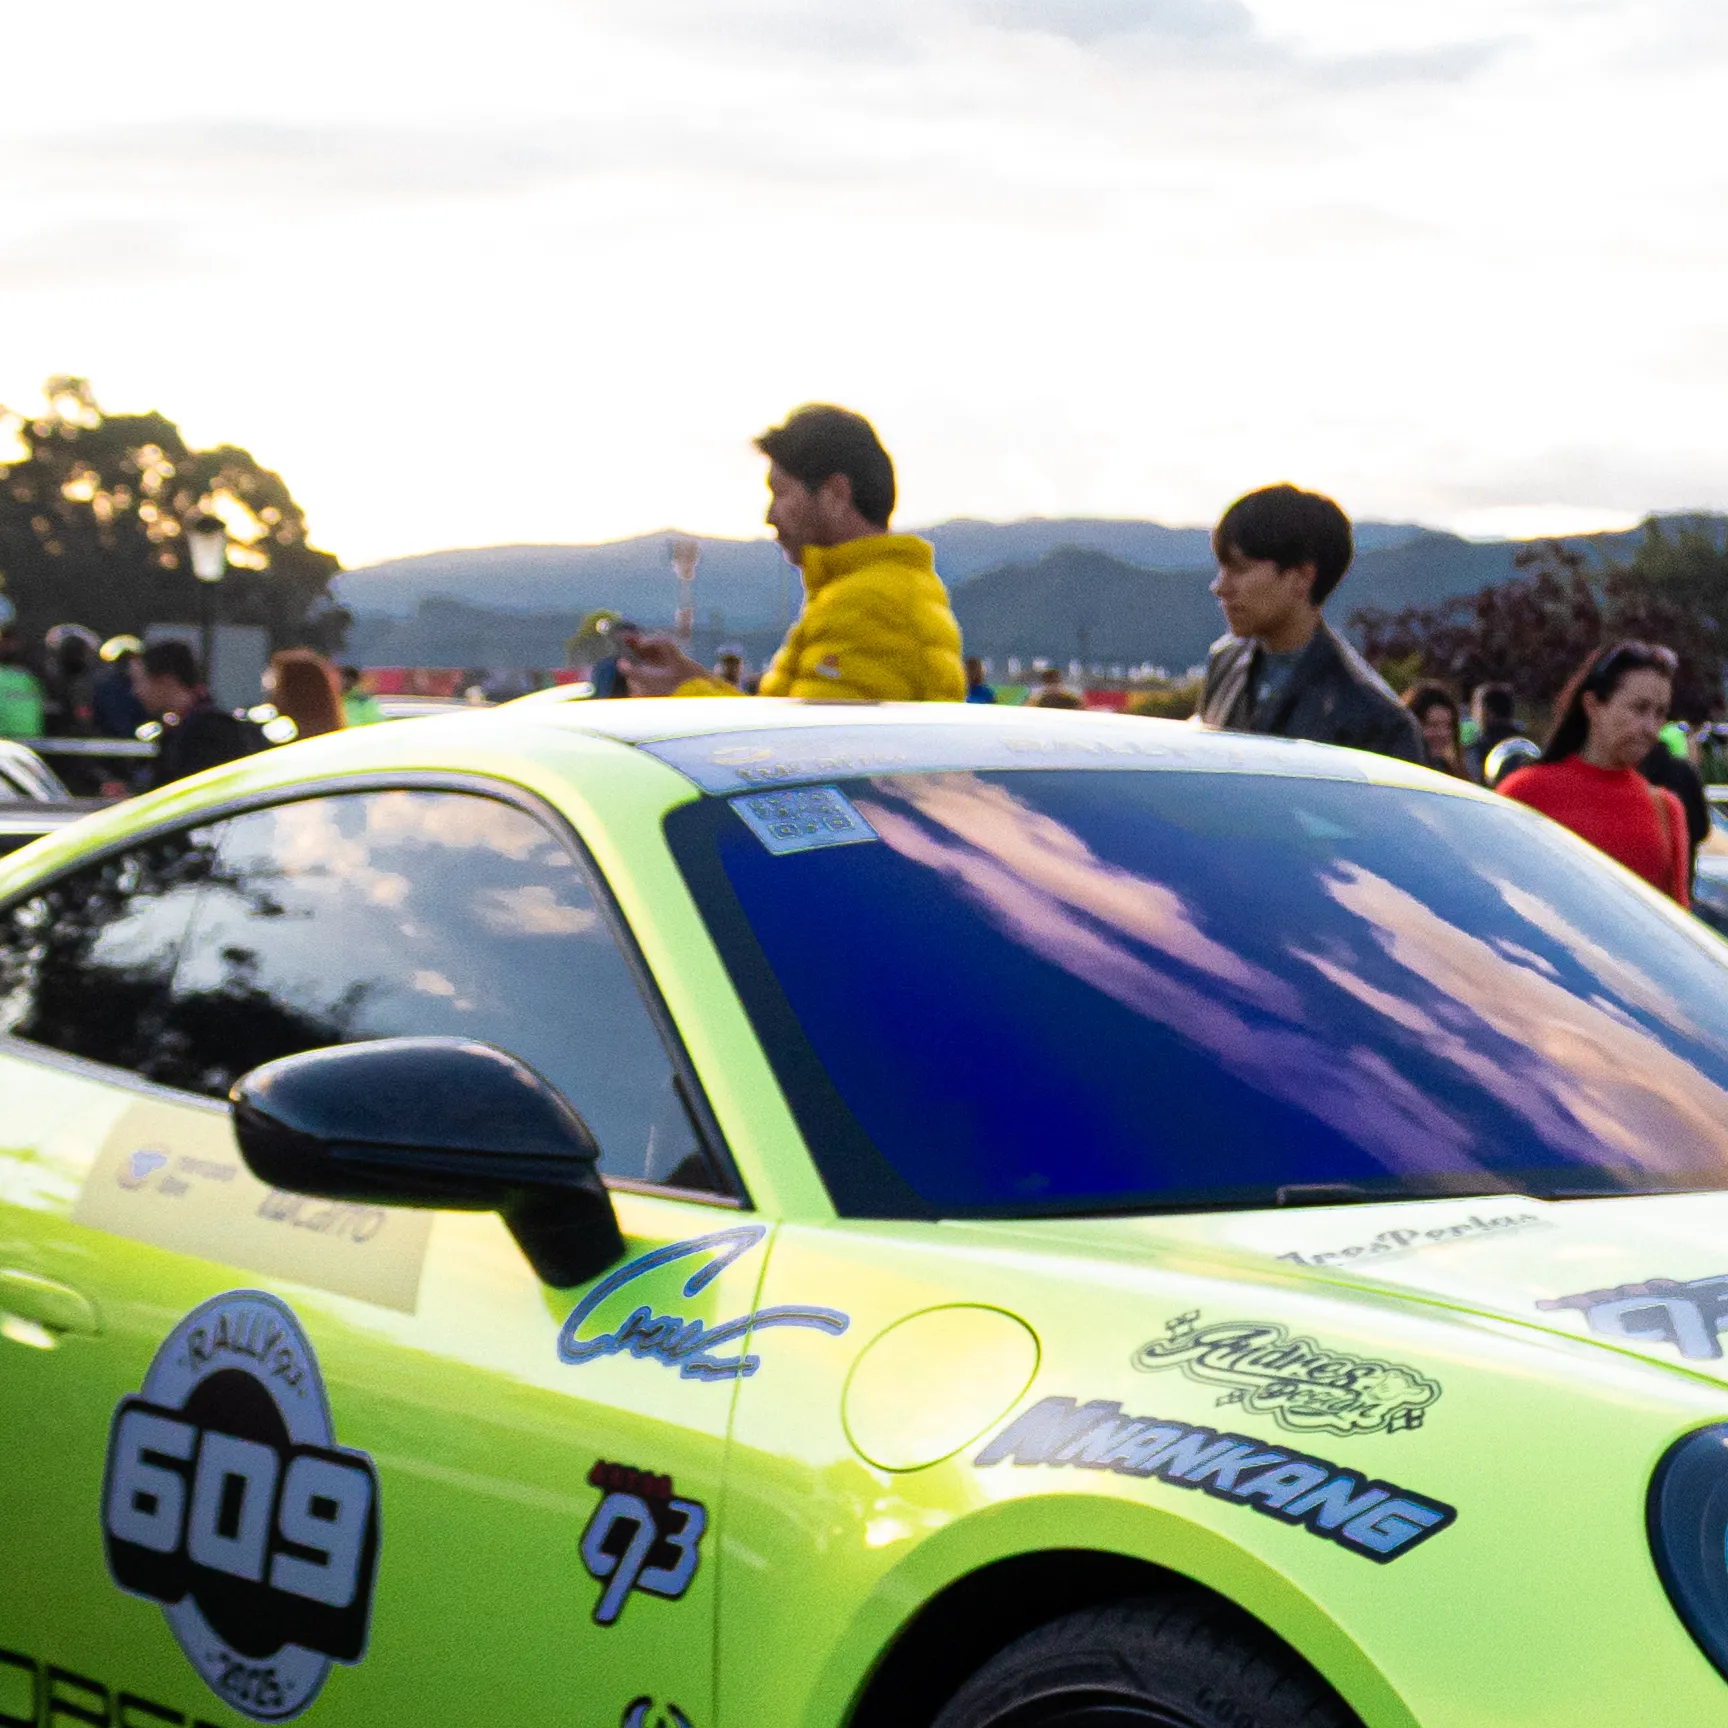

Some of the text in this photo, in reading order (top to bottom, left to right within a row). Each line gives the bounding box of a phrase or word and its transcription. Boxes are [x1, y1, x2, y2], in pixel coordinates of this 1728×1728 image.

[110, 1408, 374, 1609] 609
[1055, 1416, 1446, 1555] NANKANG
[582, 1492, 707, 1621] 93
